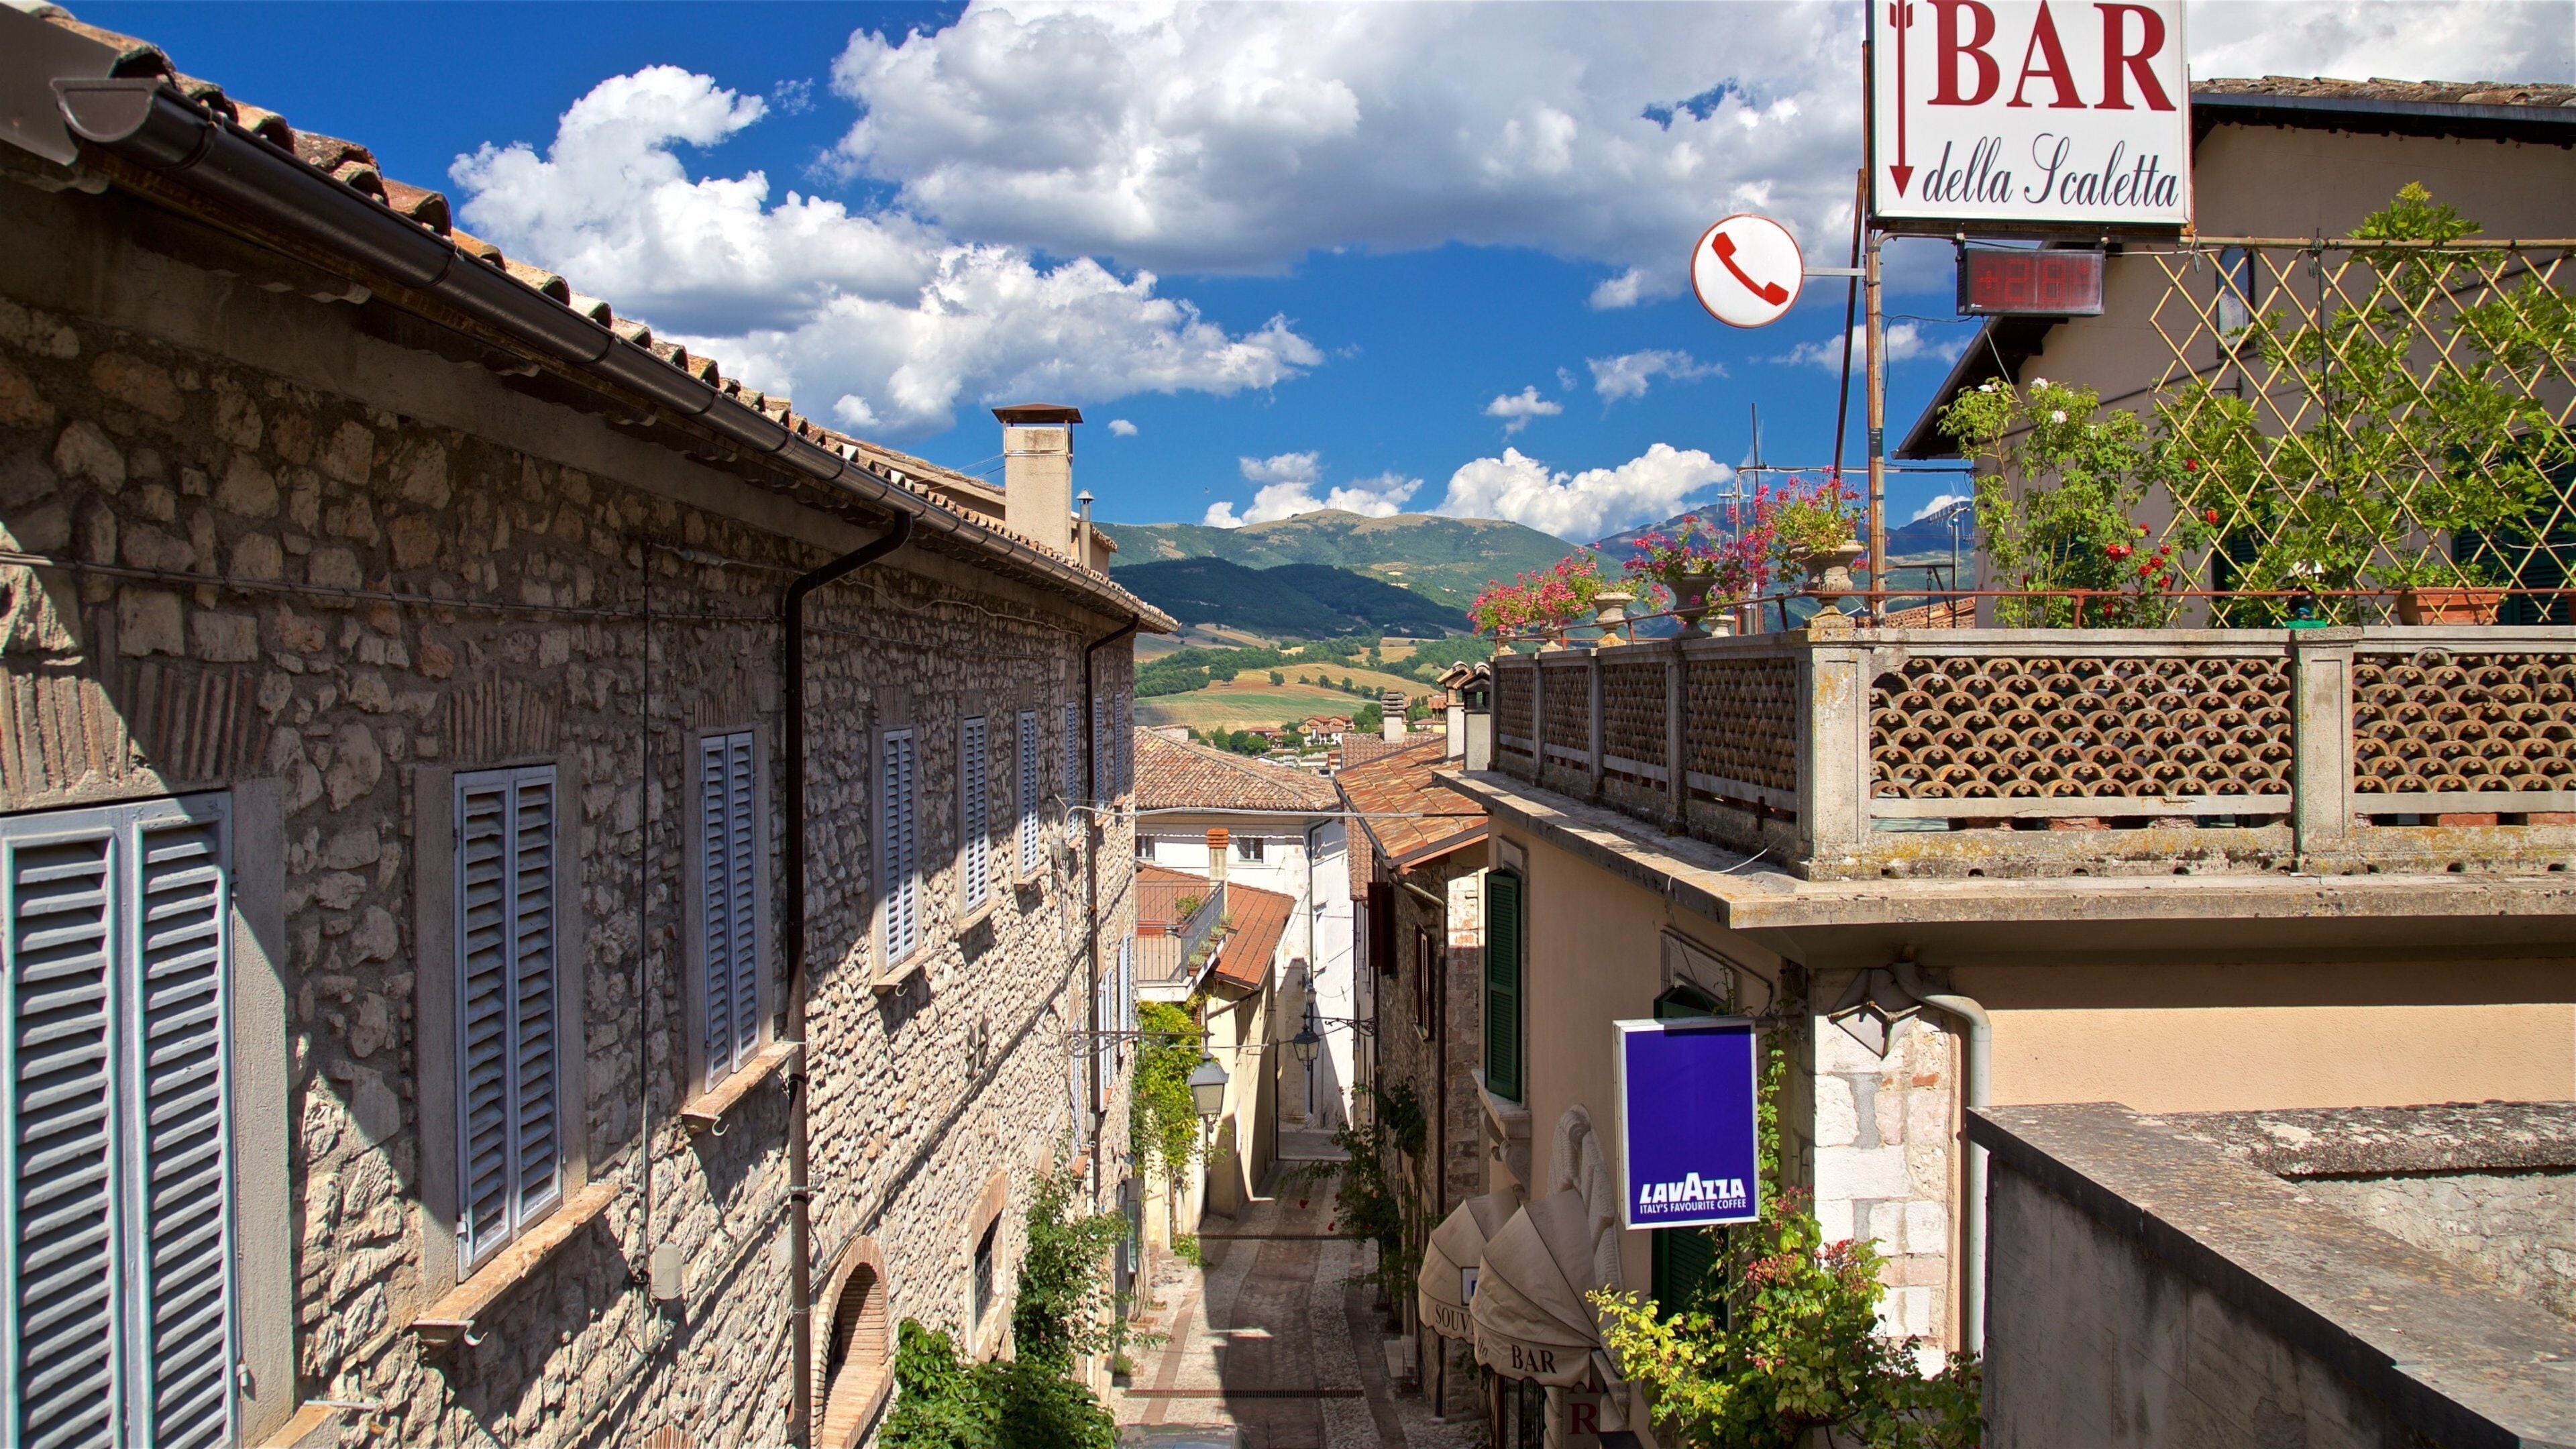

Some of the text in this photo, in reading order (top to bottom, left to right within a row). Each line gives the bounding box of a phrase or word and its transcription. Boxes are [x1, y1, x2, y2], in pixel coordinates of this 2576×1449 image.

[1927, 0, 2177, 111] BAR
[1923, 133, 2179, 207] della Scaletta
[1639, 1172, 1747, 1204] LAVAZZA
[1640, 1199, 1747, 1214] ITALY'S FAVOURITE COFFEE
[1435, 1303, 1474, 1336] SOUV
[1511, 1344, 1557, 1374] BAR
